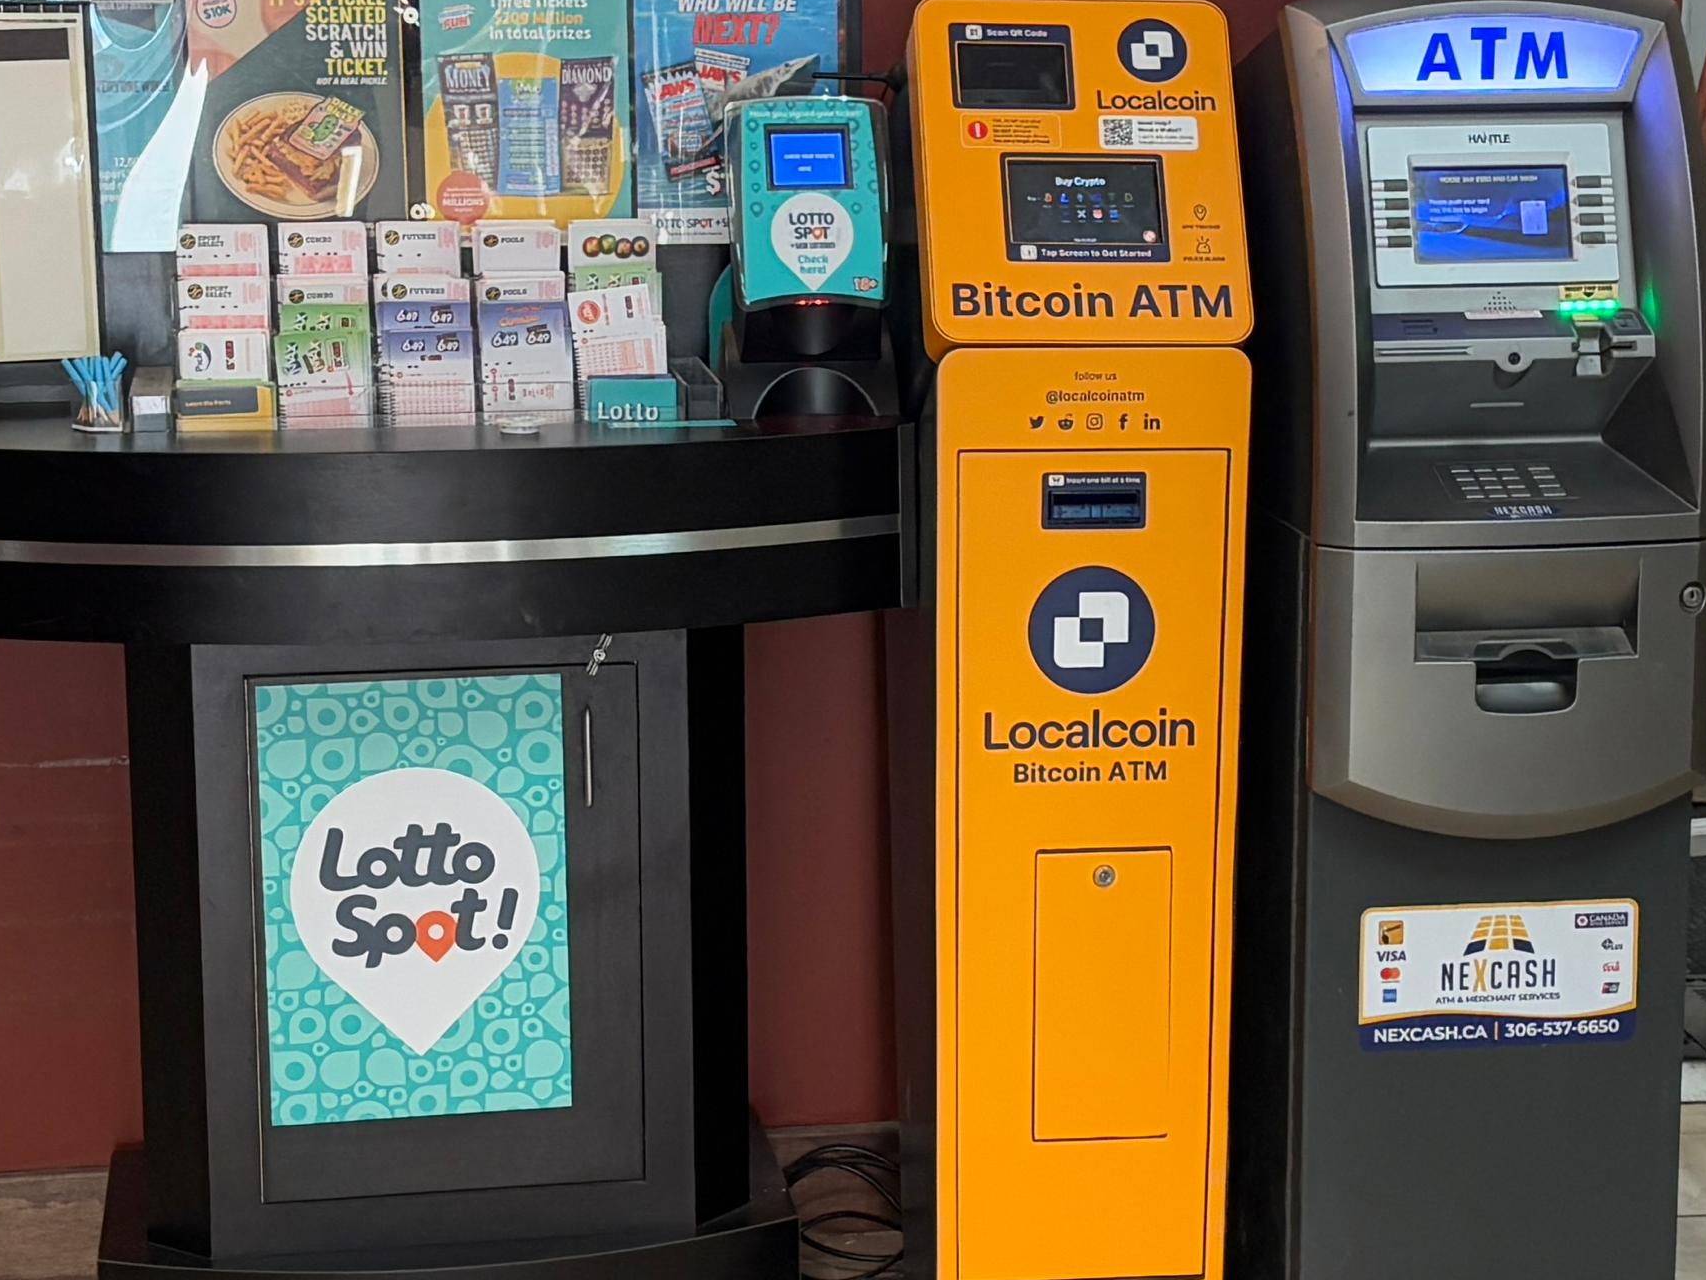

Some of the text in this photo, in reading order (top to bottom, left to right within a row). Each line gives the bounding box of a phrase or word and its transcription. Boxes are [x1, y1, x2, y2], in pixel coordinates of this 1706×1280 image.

[203, 5, 230, 20] $10K
[305, 7, 386, 23] SCENTED
[305, 24, 387, 40] SCRATCH
[490, 26, 591, 43] in total prizes
[693, 13, 780, 46] NEXT?
[986, 28, 1048, 38] Scan QR Code
[330, 41, 387, 58] & WIN
[1416, 26, 1569, 81] ATM
[325, 58, 388, 75] TICKET.
[444, 65, 491, 89] MONEY
[561, 67, 613, 84] DIAMOND
[1096, 90, 1217, 112] Localcoin
[1055, 176, 1106, 188] Buy Crypto
[686, 219, 713, 229] SPOT
[789, 213, 834, 226] LOTTO
[794, 227, 831, 240] SPOT
[1041, 248, 1152, 259] Tap Screen to Get Started
[951, 283, 1233, 318] Bitcoin ATM
[1074, 371, 1117, 381] follow us
[1046, 390, 1145, 405] @localcoinatm
[597, 401, 660, 421] Lotto
[1494, 505, 1552, 517] NEXCASH
[984, 707, 1195, 750] Localcoin
[1013, 761, 1168, 784] Bitcoin ATM
[319, 822, 496, 892] Lotto
[331, 887, 519, 969] Spot!
[1376, 951, 1406, 962] VISA
[1441, 959, 1556, 992] NEXCASH
[1436, 996, 1455, 1004] ATM
[1466, 993, 1517, 1003] MERCHANT
[1519, 992, 1561, 1001] SERVICES
[1374, 1019, 1620, 1043] NEXCASH.CA 306-537-6650
